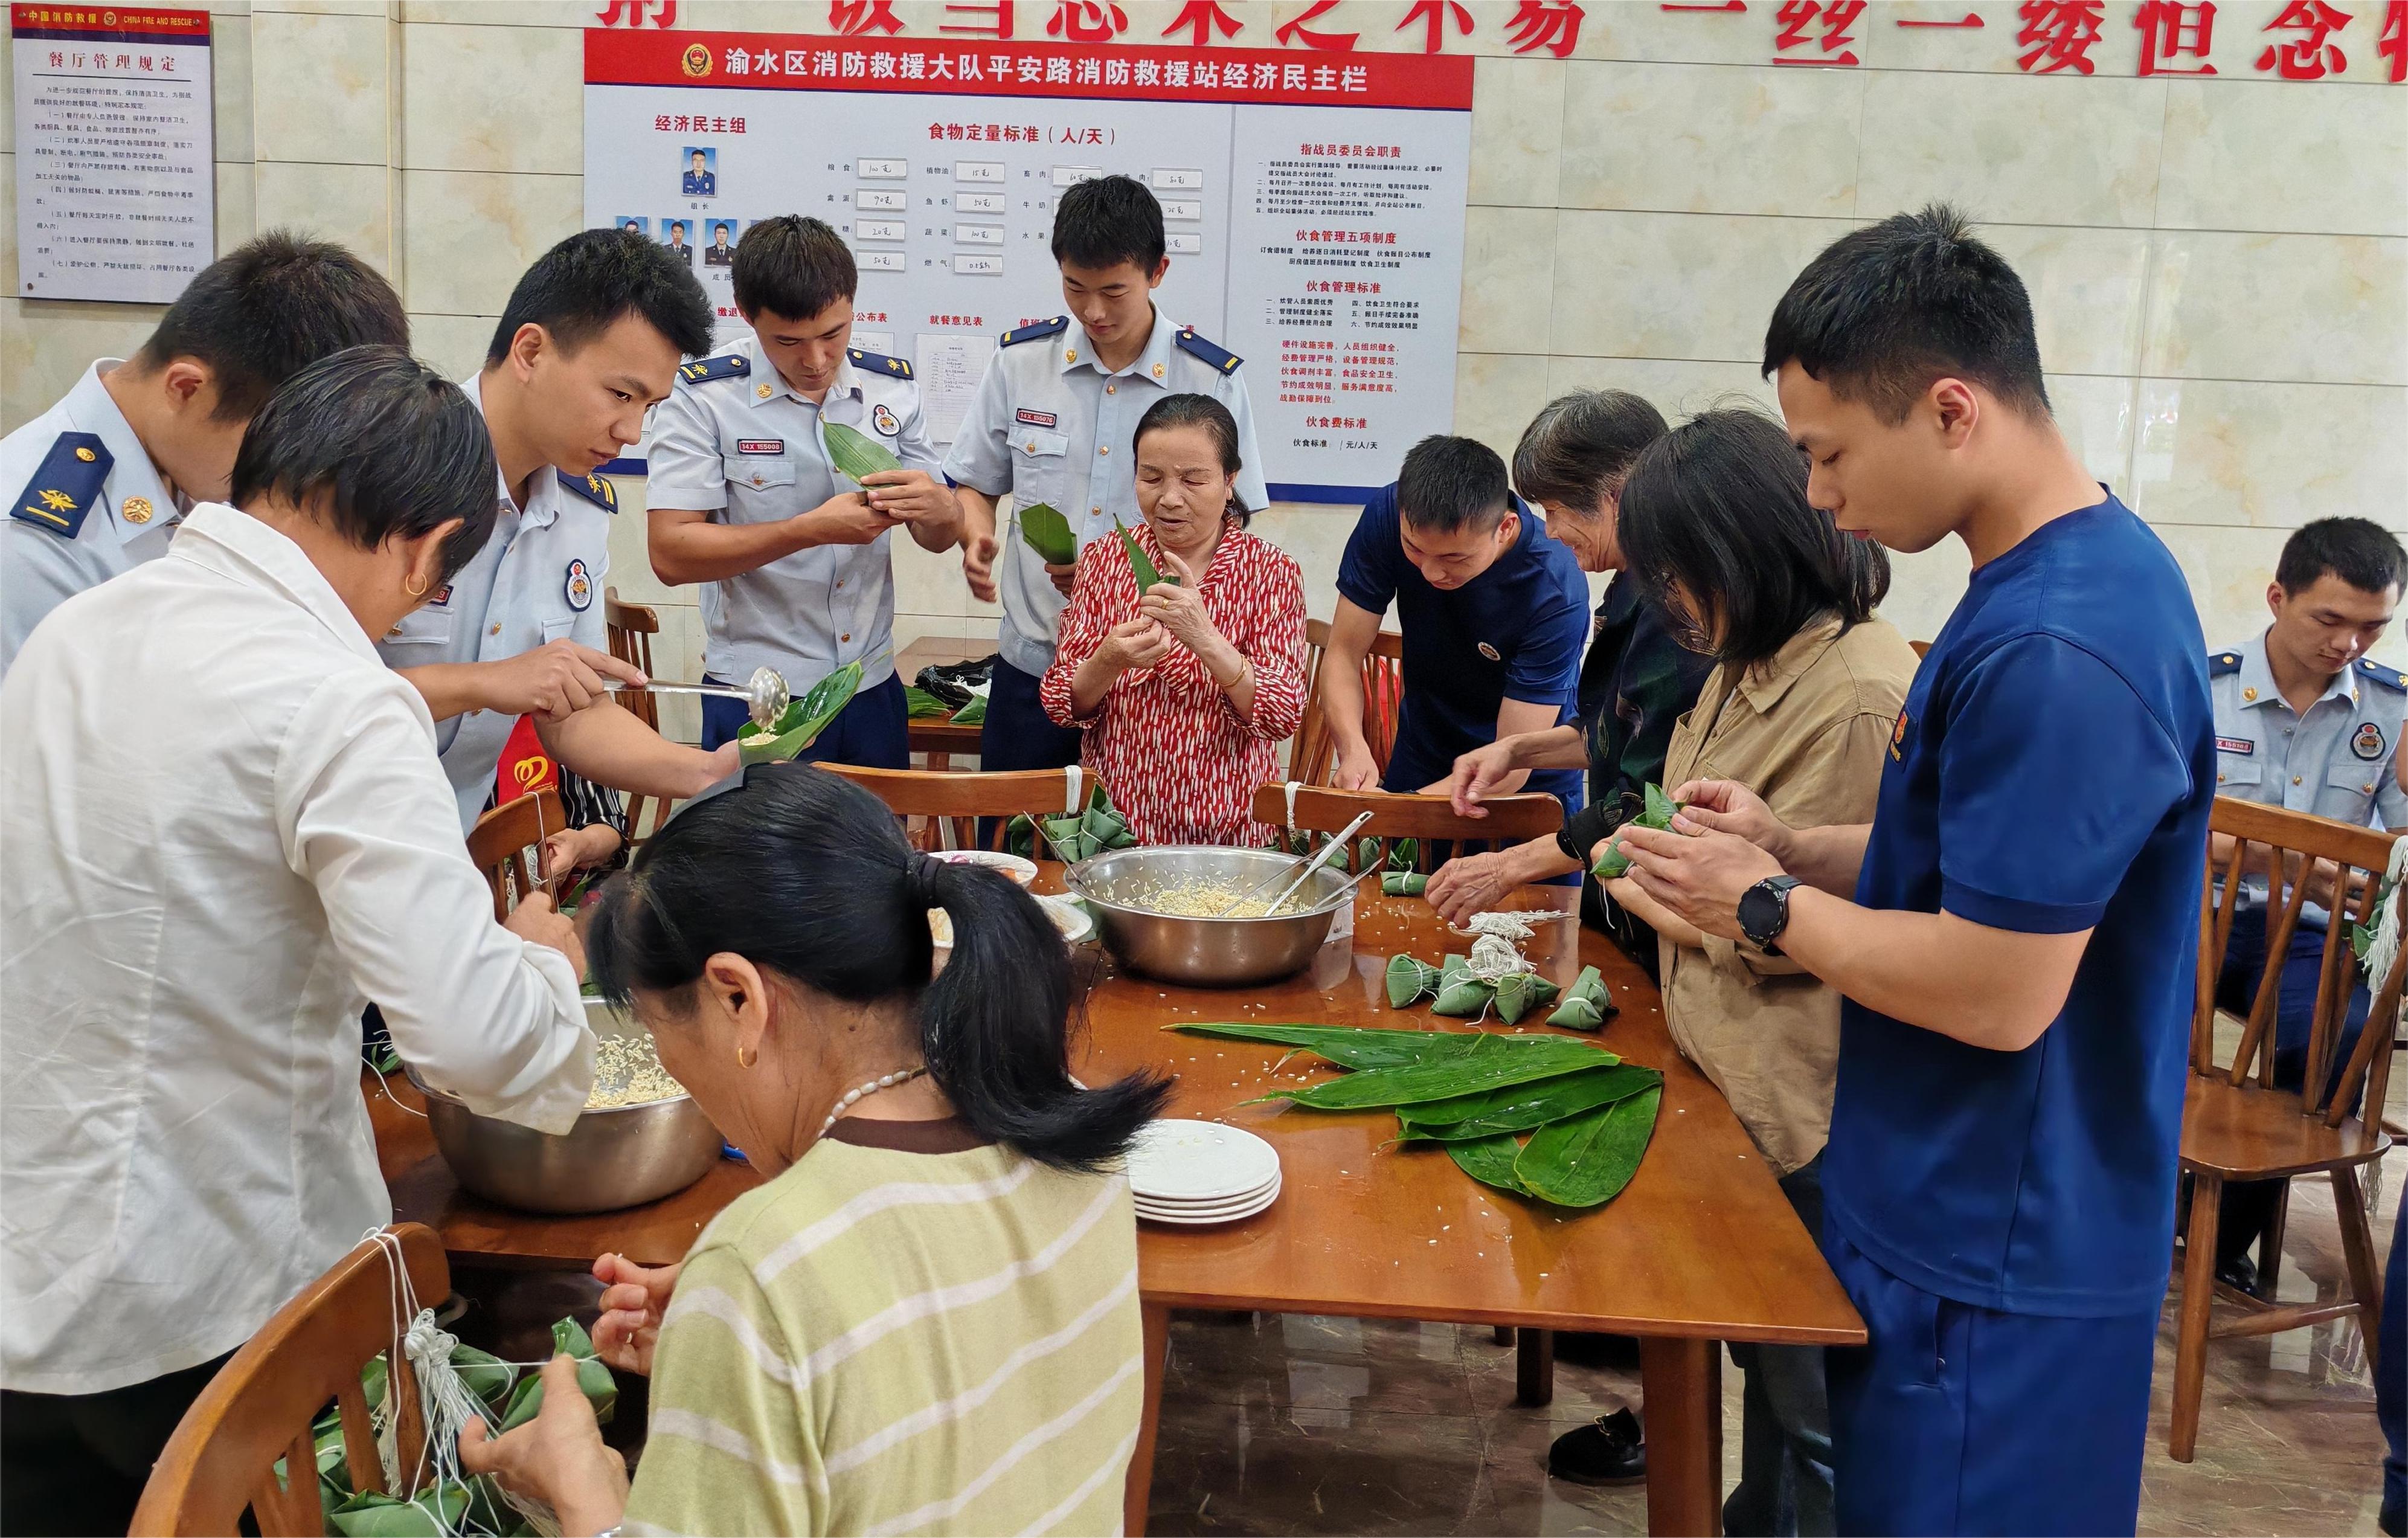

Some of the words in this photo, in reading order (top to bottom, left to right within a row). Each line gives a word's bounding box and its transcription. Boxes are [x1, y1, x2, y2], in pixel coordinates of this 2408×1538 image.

[29, 10, 97, 24] 中国消防救援
[170, 18, 193, 26] RESCUE
[49, 51, 175, 71] 餐厅管理规定
[725, 47, 1367, 92] 渝水区消防救援大队平安路消防救援站经济民主栏
[655, 115, 746, 134] 经济民主组
[1300, 144, 1401, 158] 指战员委员会职责
[1296, 230, 1396, 244] 伙食管理五项制度
[1302, 248, 1369, 257] 给养逐日消耗登记制度
[1360, 260, 1400, 268] 饮食卫生制度
[1306, 280, 1381, 294] 伙食管理标准
[852, 312, 887, 323] 公布表
[930, 315, 983, 326] 就餐意见表
[1306, 416, 1367, 429] 伙食费标准
